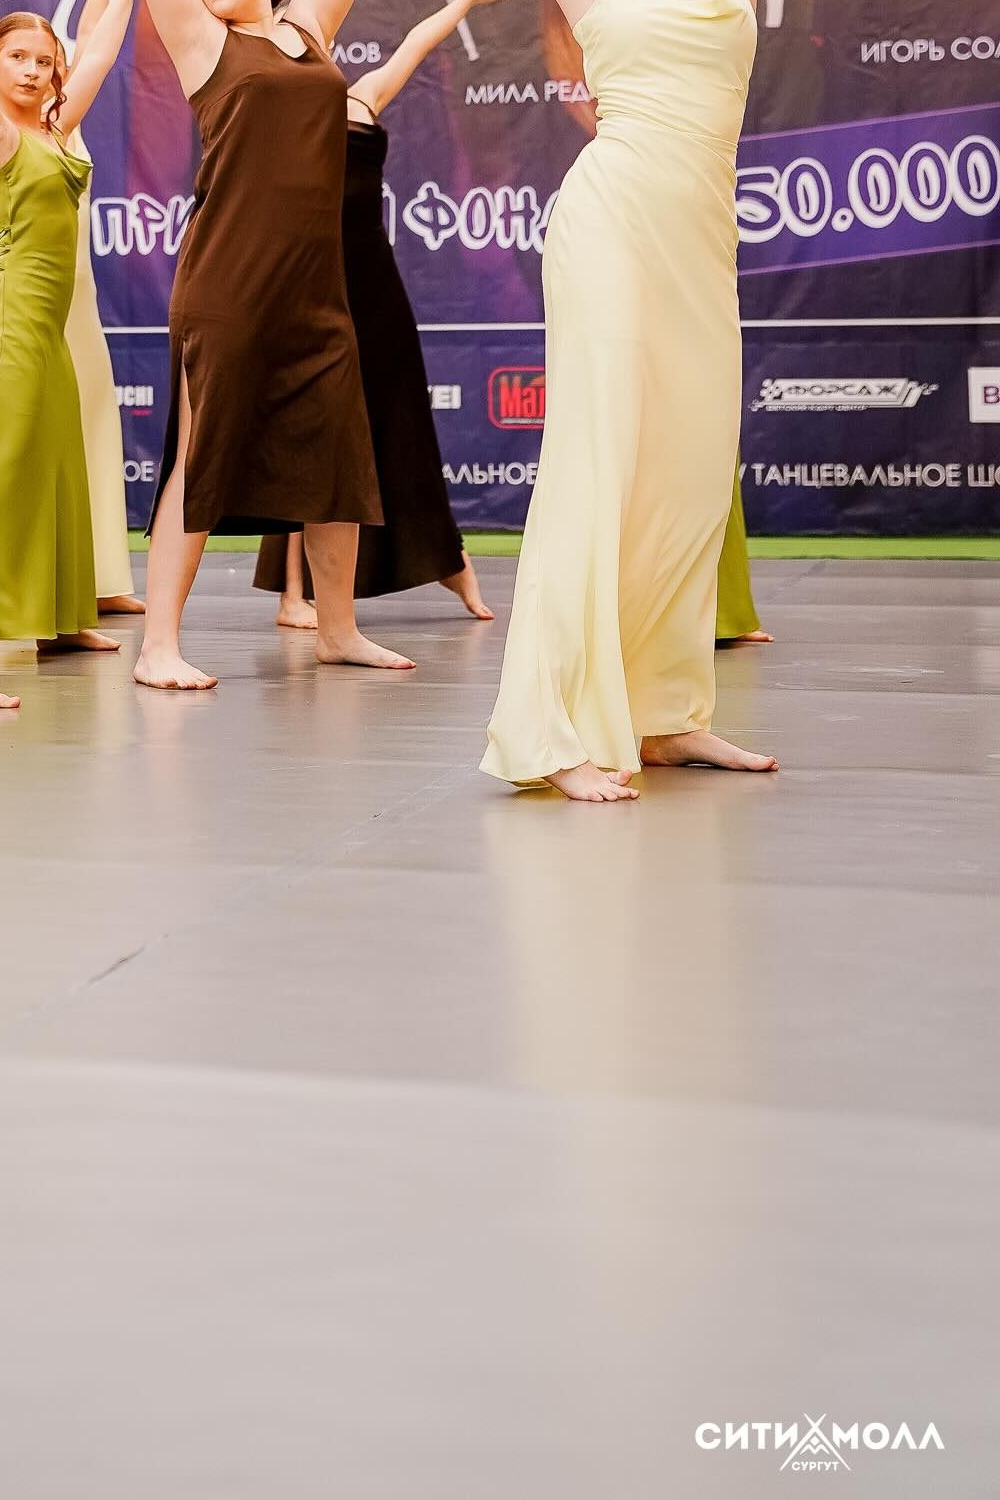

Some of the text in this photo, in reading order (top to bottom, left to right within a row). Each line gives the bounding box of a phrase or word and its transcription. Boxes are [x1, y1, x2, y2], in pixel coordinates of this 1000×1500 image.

[861, 35, 1000, 63] ИГОРЬ СО
[465, 80, 594, 105] МИЛА РЕД
[751, 462, 962, 488] ТАНЦЕВАЛЬНОЕ
